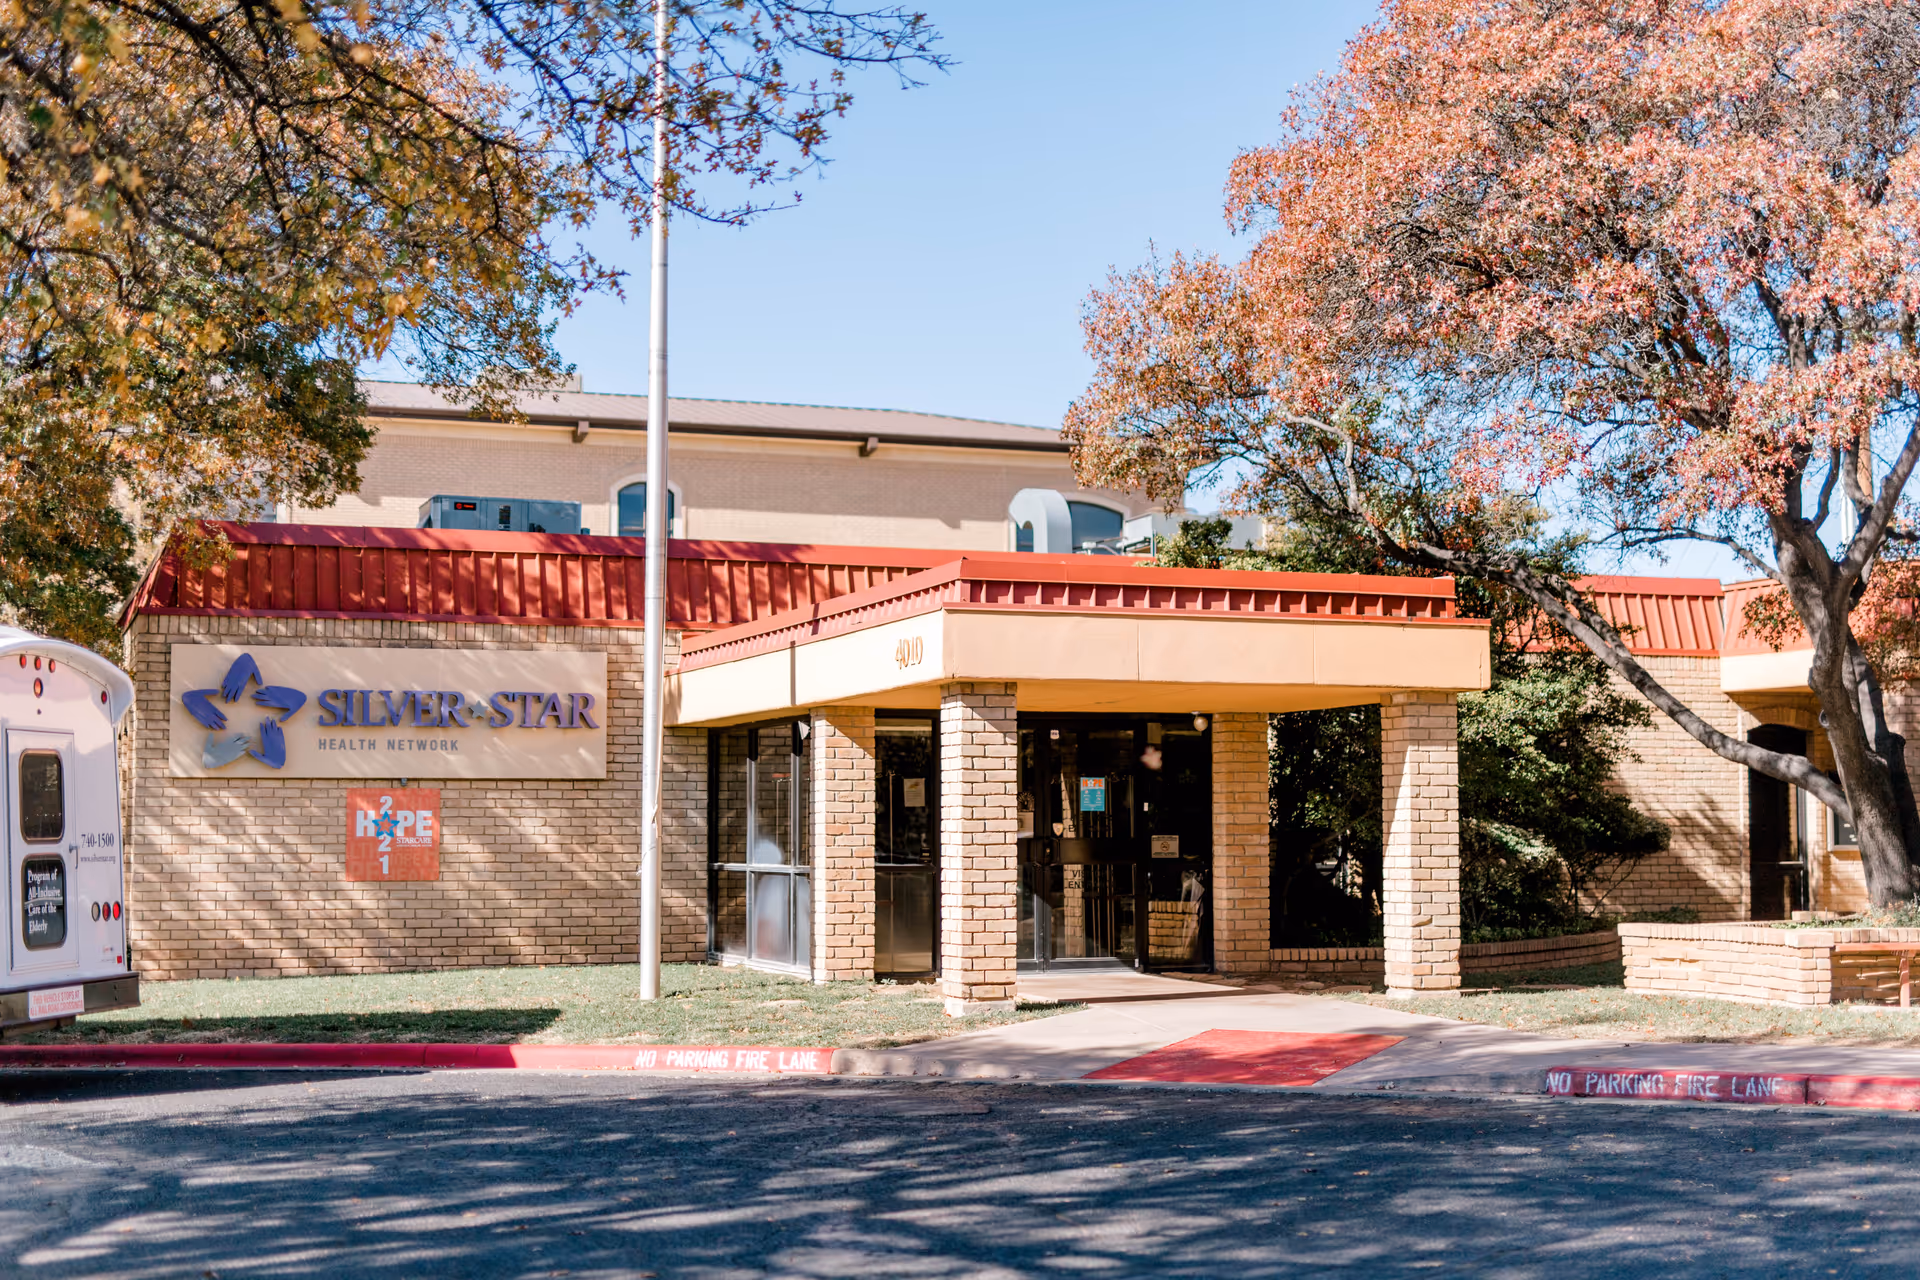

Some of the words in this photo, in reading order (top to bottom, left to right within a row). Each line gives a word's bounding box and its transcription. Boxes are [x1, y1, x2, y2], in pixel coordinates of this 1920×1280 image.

[895, 636, 924, 670] 4010
[318, 689, 470, 728] SILVER
[489, 691, 600, 729] STAR
[318, 738, 377, 751] HEALTH
[387, 738, 459, 752] NETWORK
[1082, 779, 1104, 787] HPE
[356, 810, 433, 837] HPE
[81, 832, 115, 848] 740-1500
[28, 869, 51, 884] Program
[51, 868, 58, 880] of
[28, 886, 60, 900] All-Inclusive
[28, 903, 41, 916] Care
[48, 902, 57, 913] the
[29, 920, 48, 934] Elderly
[636, 1050, 657, 1068] NO
[667, 1050, 728, 1068] PARKING
[735, 1050, 770, 1070] FIRE
[779, 1051, 817, 1070] LANE
[1546, 1072, 1571, 1094] NO
[1586, 1072, 1664, 1094] PARKING
[1674, 1074, 1720, 1097] FIRE
